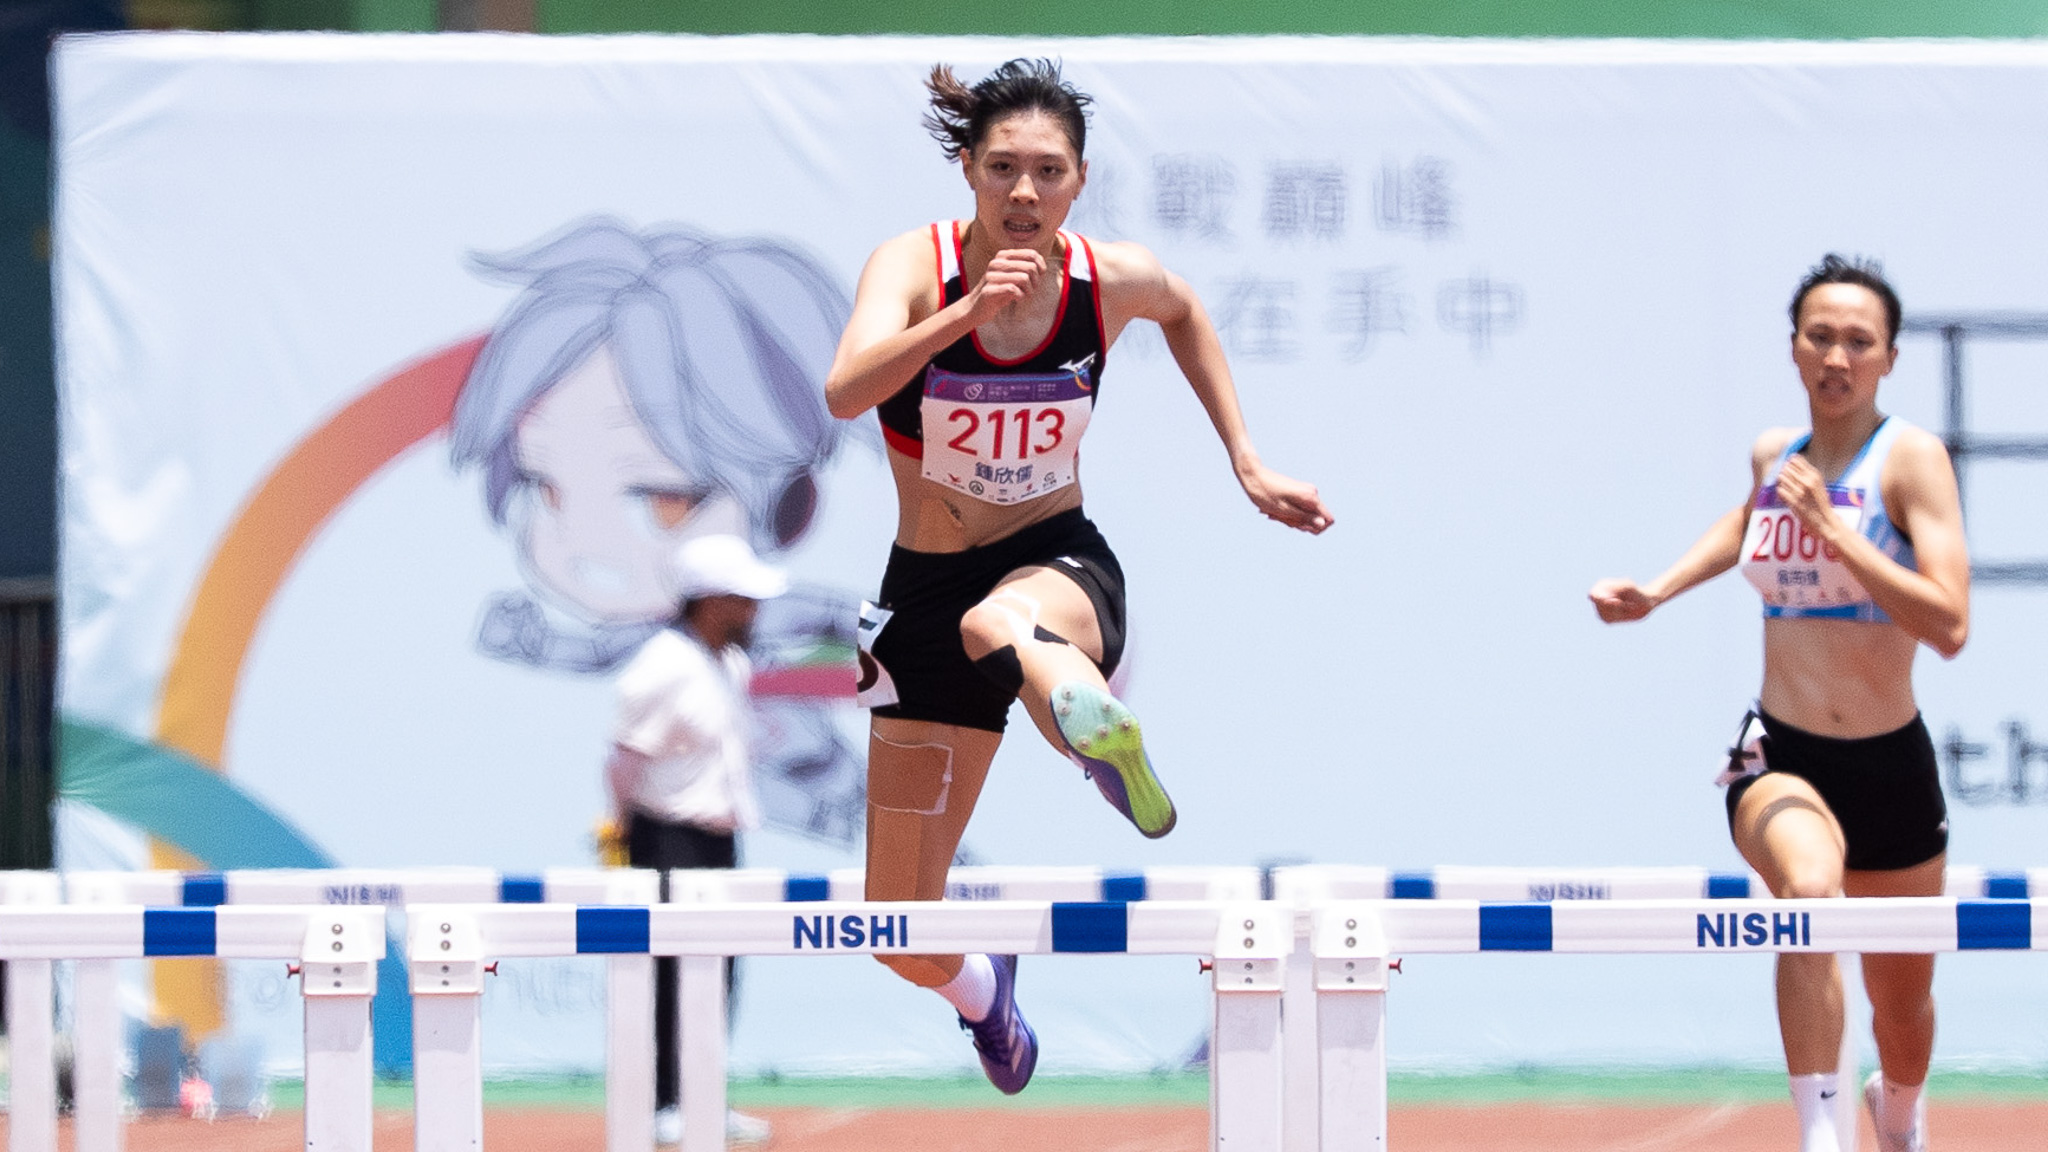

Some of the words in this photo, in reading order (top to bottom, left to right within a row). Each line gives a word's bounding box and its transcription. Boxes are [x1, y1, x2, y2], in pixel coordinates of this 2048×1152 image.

[948, 408, 1065, 460] 2113
[793, 915, 909, 949] NISHI
[1697, 912, 1811, 948] NISHI
